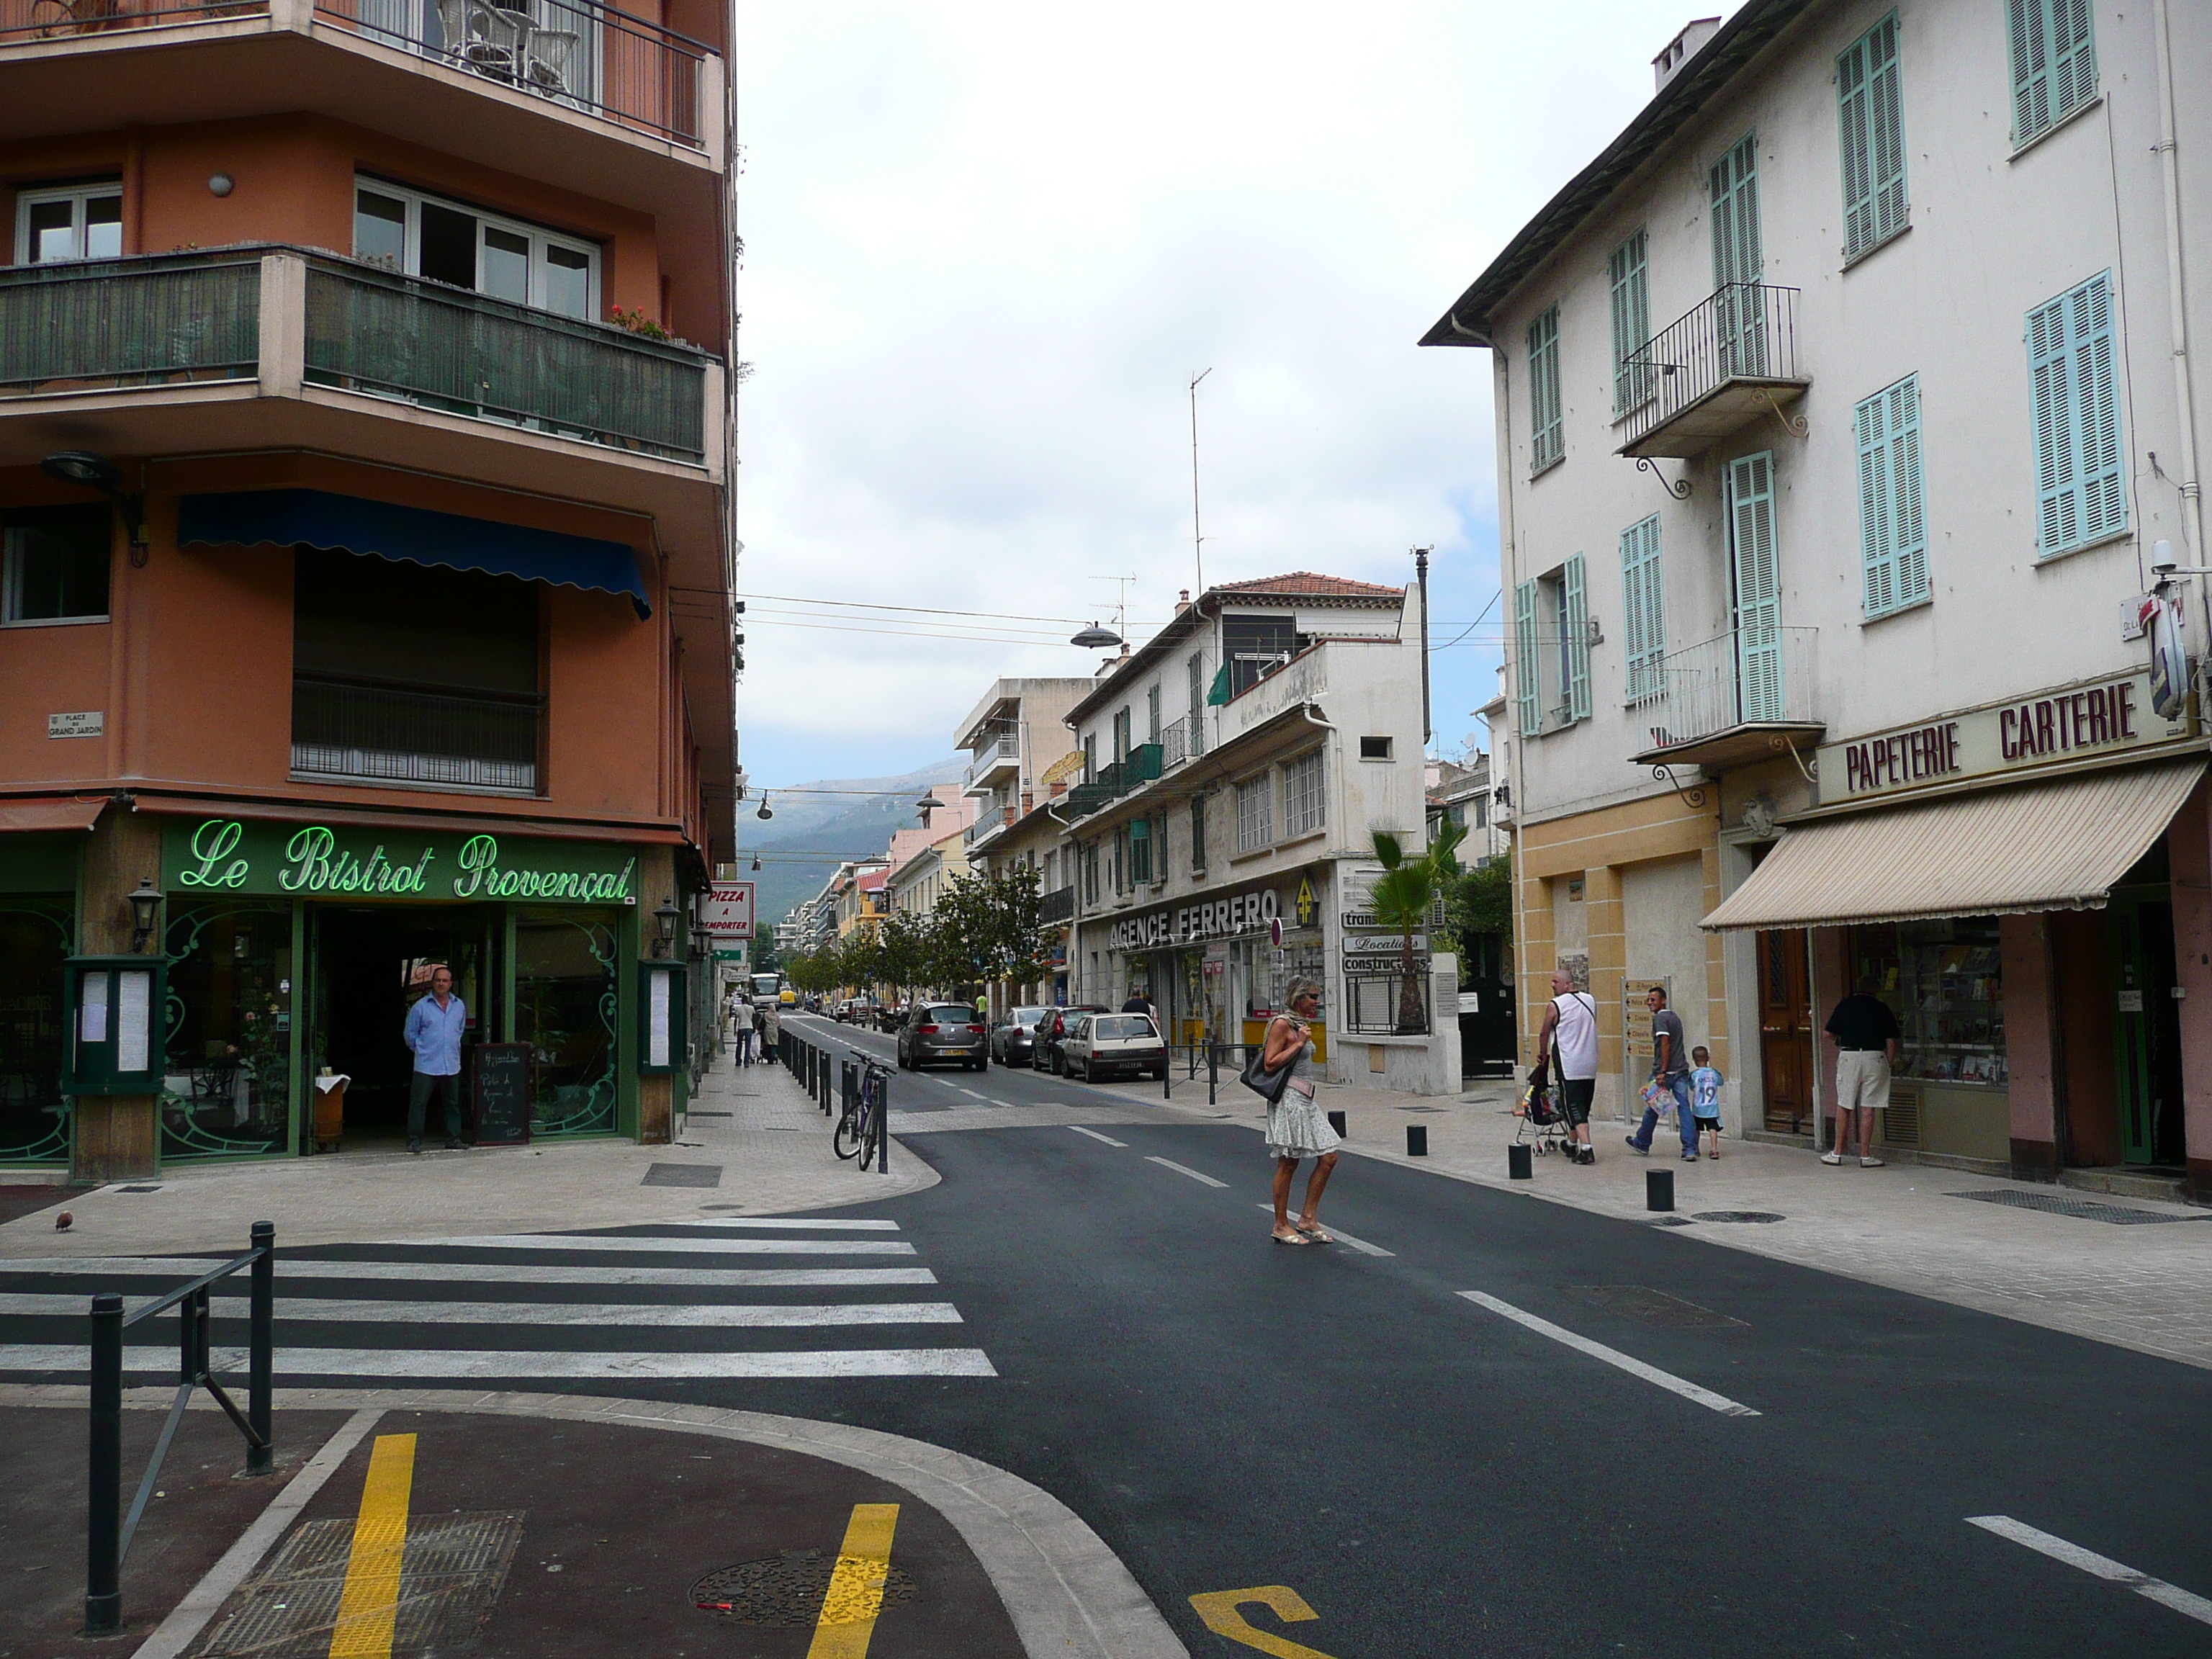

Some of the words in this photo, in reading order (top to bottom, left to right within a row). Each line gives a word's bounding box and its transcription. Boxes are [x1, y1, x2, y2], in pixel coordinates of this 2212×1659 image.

[1846, 721, 1961, 791] PAPETERIE
[2000, 681, 2138, 760] CARTERIE
[180, 819, 248, 888] Le
[279, 827, 435, 894] Bistrot
[454, 835, 635, 904] Provençal
[708, 891, 745, 902] PIZZA
[1110, 912, 1169, 950] AGENCE
[1179, 889, 1278, 940] FERRERO
[1354, 937, 1419, 950] Locatios
[1699, 1086, 1716, 1105] 19
